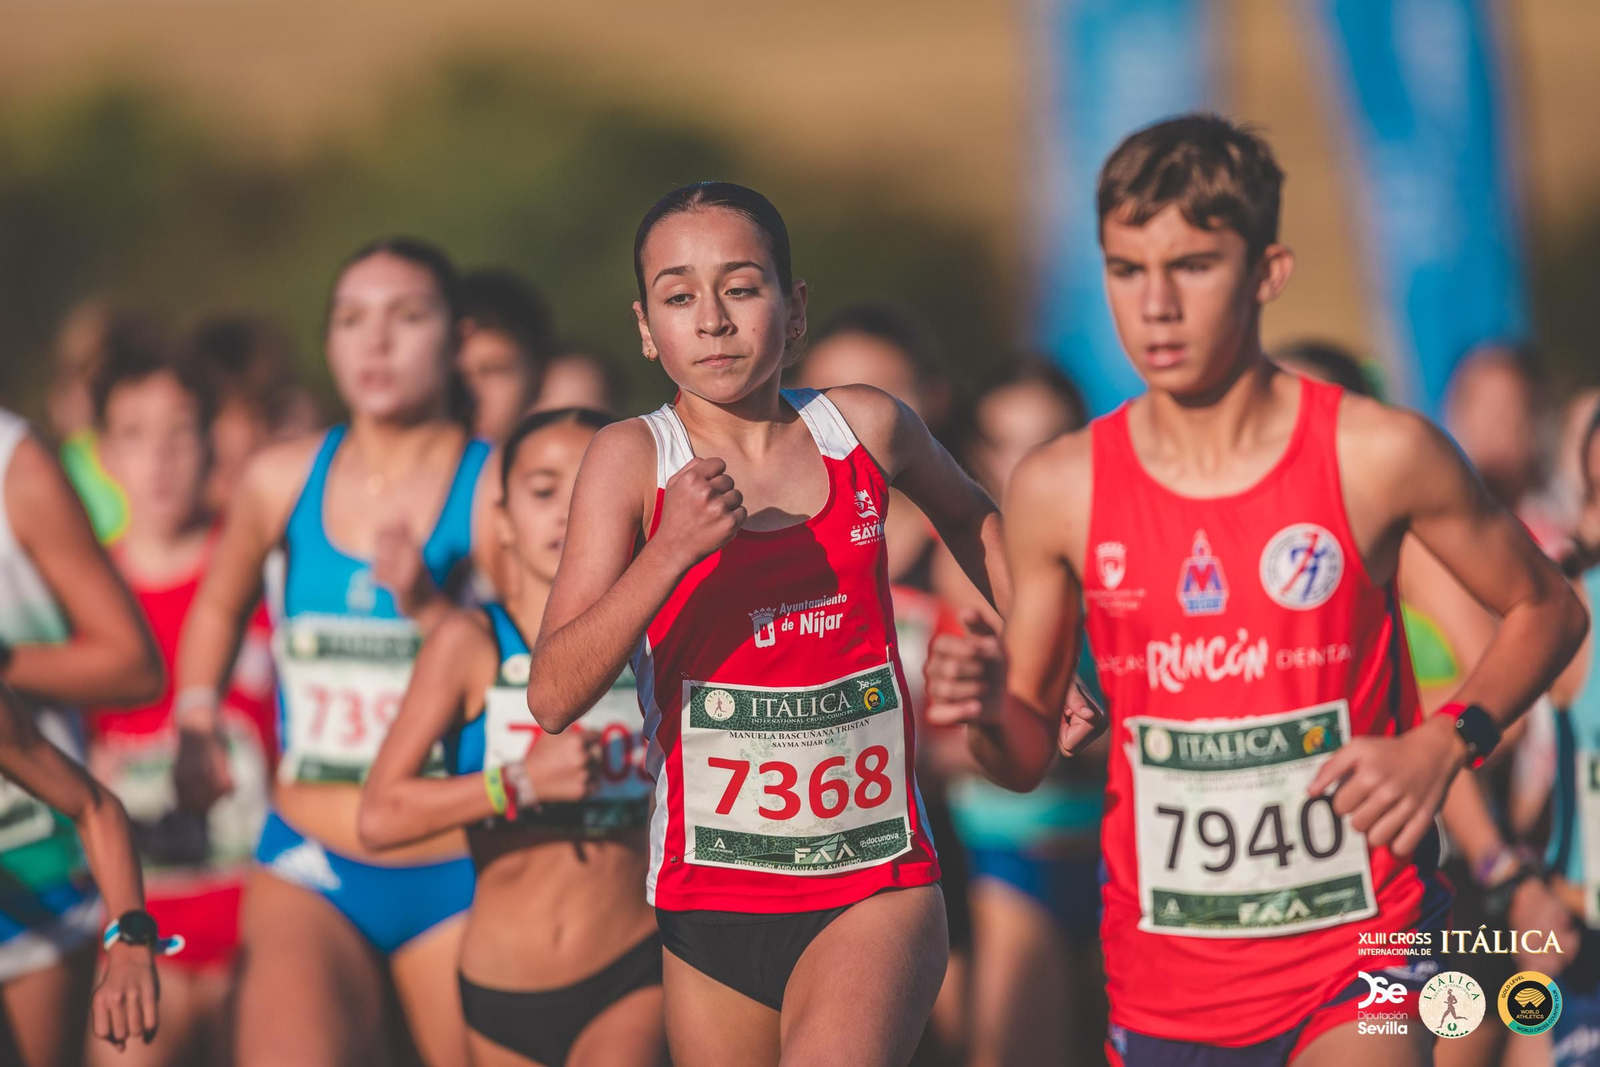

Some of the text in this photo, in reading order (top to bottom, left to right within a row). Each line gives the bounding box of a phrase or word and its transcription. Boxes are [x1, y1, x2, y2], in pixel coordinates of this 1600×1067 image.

[779, 593, 847, 616] Ayuntamiento
[781, 610, 843, 638] de Níjar
[751, 690, 851, 718] ITÁLICA
[729, 718, 870, 740] MANUELA BASCUÑANA TRISTAN
[801, 739, 823, 747] NIJAR
[708, 745, 892, 821] 7368
[866, 832, 899, 845] docunova
[1157, 795, 1343, 873] 7940
[735, 860, 775, 869] FEDERACIÓN
